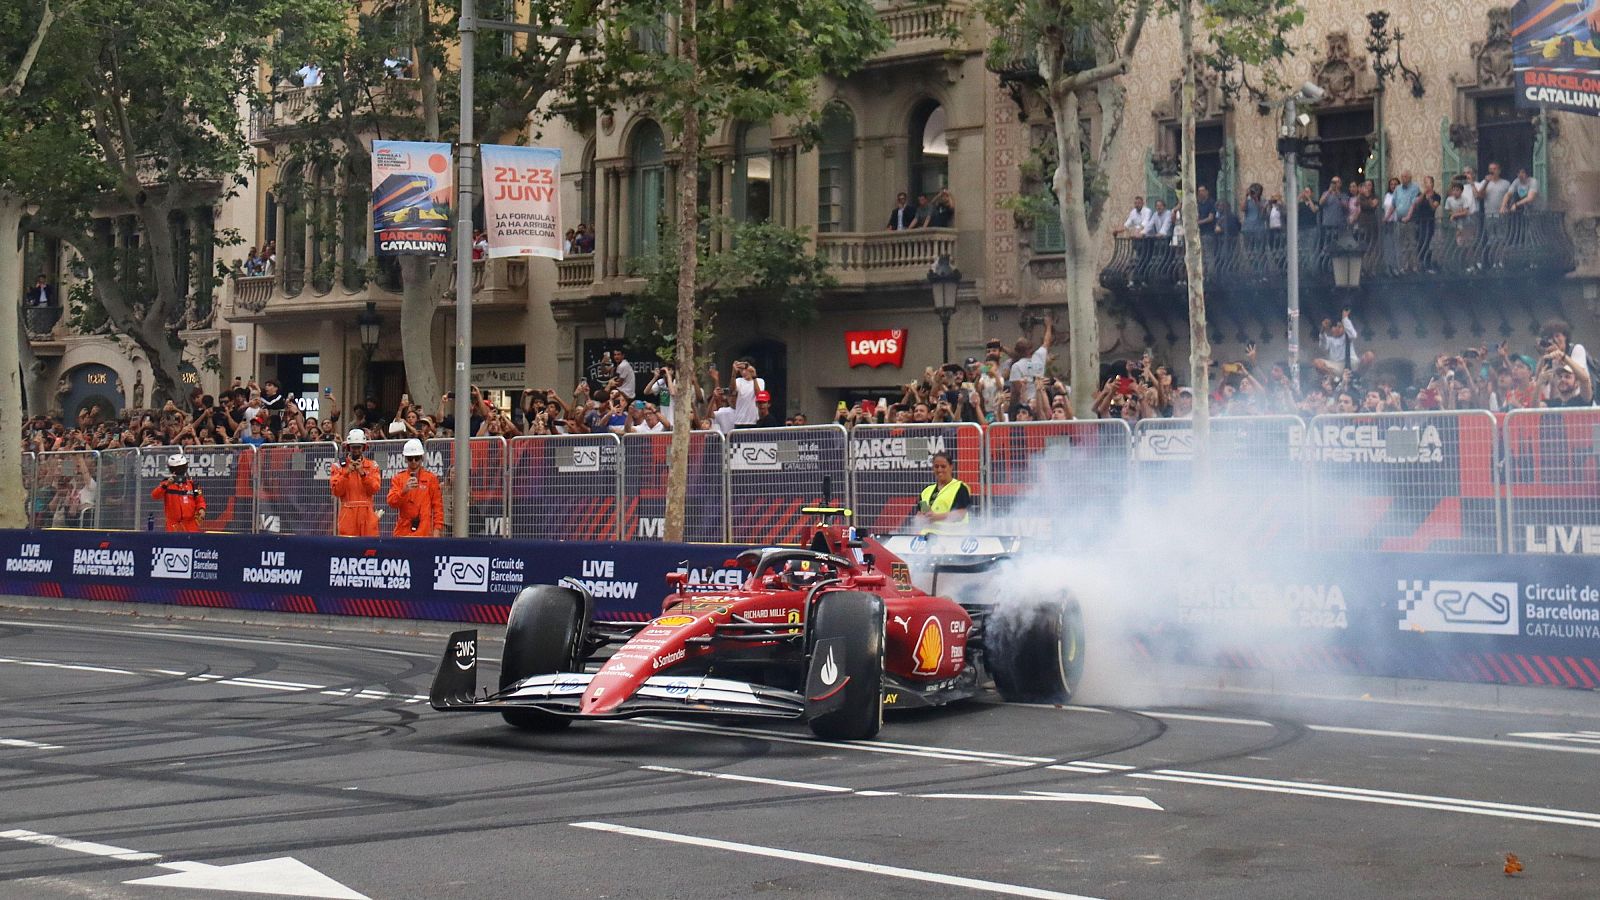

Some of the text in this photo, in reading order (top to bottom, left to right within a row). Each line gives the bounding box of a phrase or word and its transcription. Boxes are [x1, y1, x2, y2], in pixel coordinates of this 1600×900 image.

[1524, 71, 1600, 92] BARCELON
[1525, 86, 1600, 108] CATALUNY
[495, 166, 553, 185] 21-23
[495, 185, 555, 202] JUNY
[510, 213, 550, 221] FORMULA
[523, 222, 556, 230] ARRIBAT
[381, 232, 447, 242] BARCELONA
[506, 229, 555, 238] BARCELONA
[381, 241, 446, 252] CATALUNYA
[295, 398, 319, 411] ORA
[1526, 525, 1600, 553] LIVE
[21, 544, 40, 557] LIVE
[74, 549, 134, 566] BARCELONA
[194, 550, 218, 559] Circuit de
[6, 557, 53, 573] ROADSHOW
[194, 560, 218, 570] Barcelona
[262, 551, 285, 566] LIVE
[492, 558, 524, 570] Circuit de
[73, 564, 134, 577] FAN FESTIVAL 2024
[330, 557, 411, 577] BARCELONA
[583, 560, 614, 578] LIVE
[193, 570, 217, 580] CATALUNYA
[243, 568, 302, 585] ROADSHOW
[330, 575, 411, 589] FAN FESTIVAL 2024
[491, 571, 523, 583] Barcelona
[490, 583, 523, 594] CATALUNYA
[1526, 584, 1599, 602] Circuit de
[744, 608, 786, 619] RICHARD MILLE
[1526, 603, 1600, 620] Barcelona
[1526, 622, 1600, 638] CATALUNYA
[456, 640, 475, 658] aws
[659, 648, 686, 667] Santander
